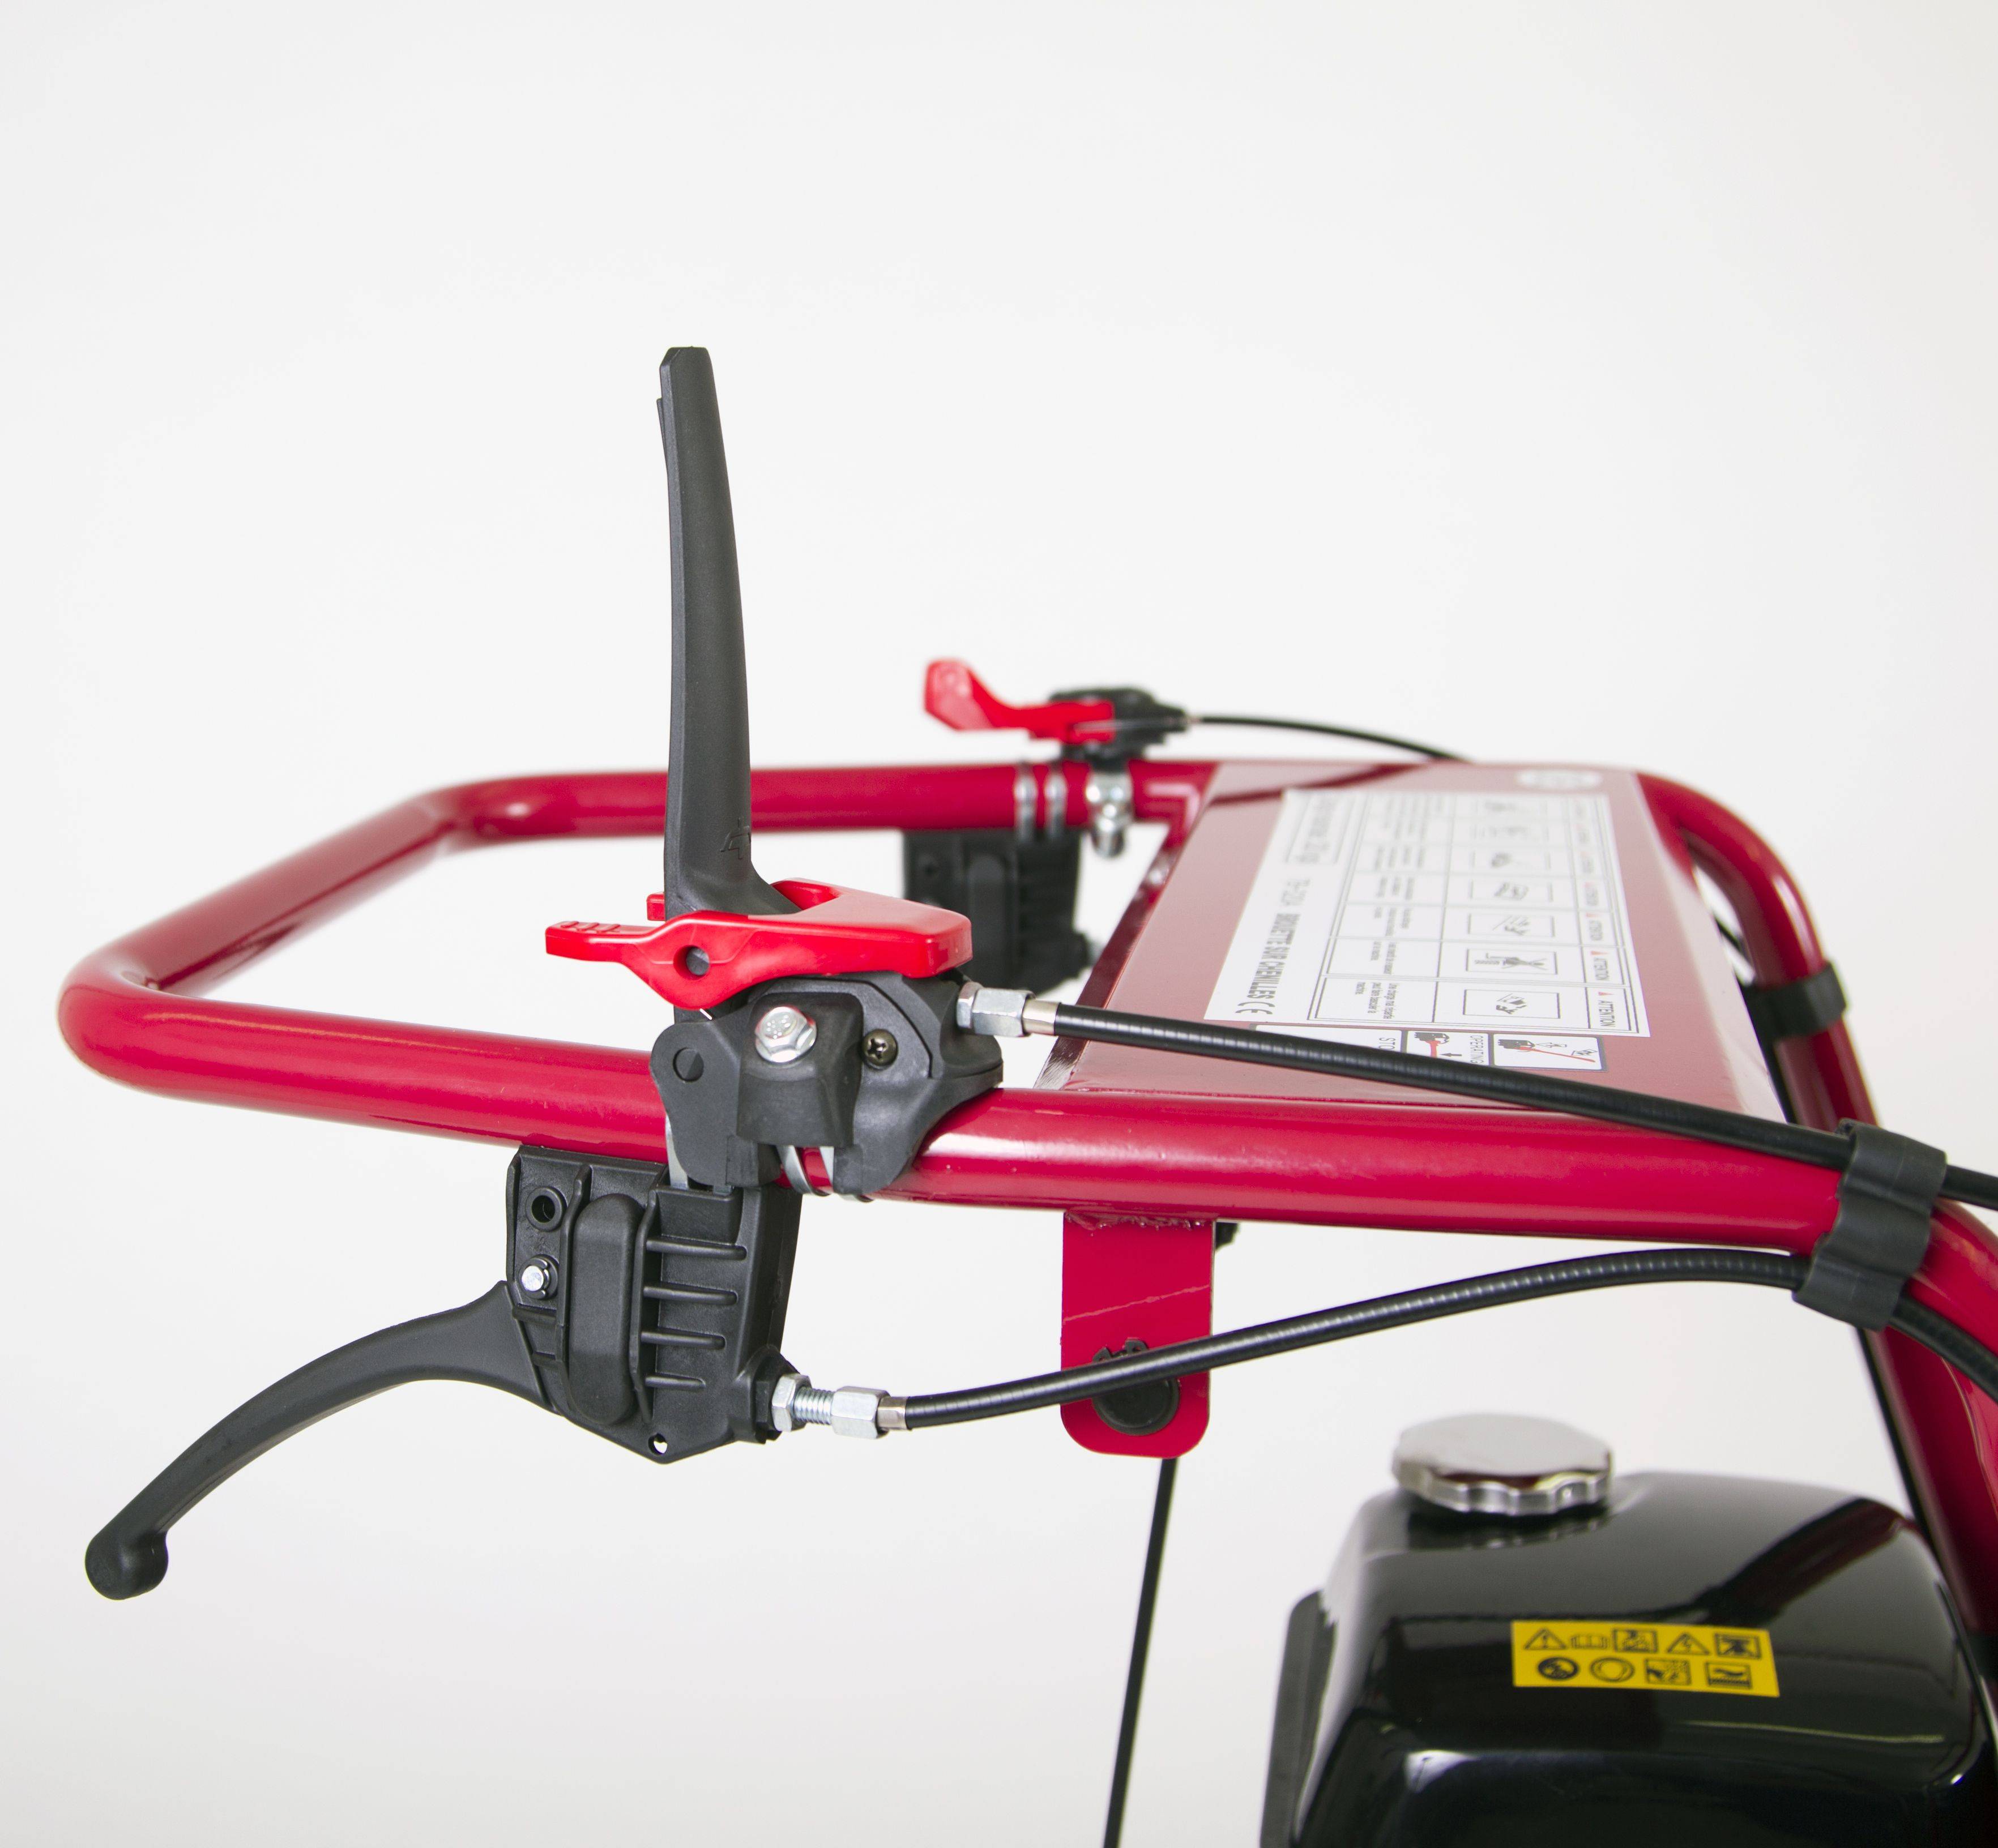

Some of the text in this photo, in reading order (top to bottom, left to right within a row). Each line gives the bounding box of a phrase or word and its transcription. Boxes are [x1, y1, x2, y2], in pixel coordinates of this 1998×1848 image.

[1267, 913, 1301, 945] BROUETTE
[1261, 946, 1290, 959] SUR
[1246, 961, 1285, 999] CHENILLES
[1594, 958, 1609, 981] ATTENTION
[1368, 996, 1378, 1009] basculer
[1384, 990, 1396, 1000] charge
[1599, 1000, 1616, 1026] ATTENTION
[1379, 1037, 1395, 1050] STO
[1470, 1035, 1484, 1064] OPERATING
